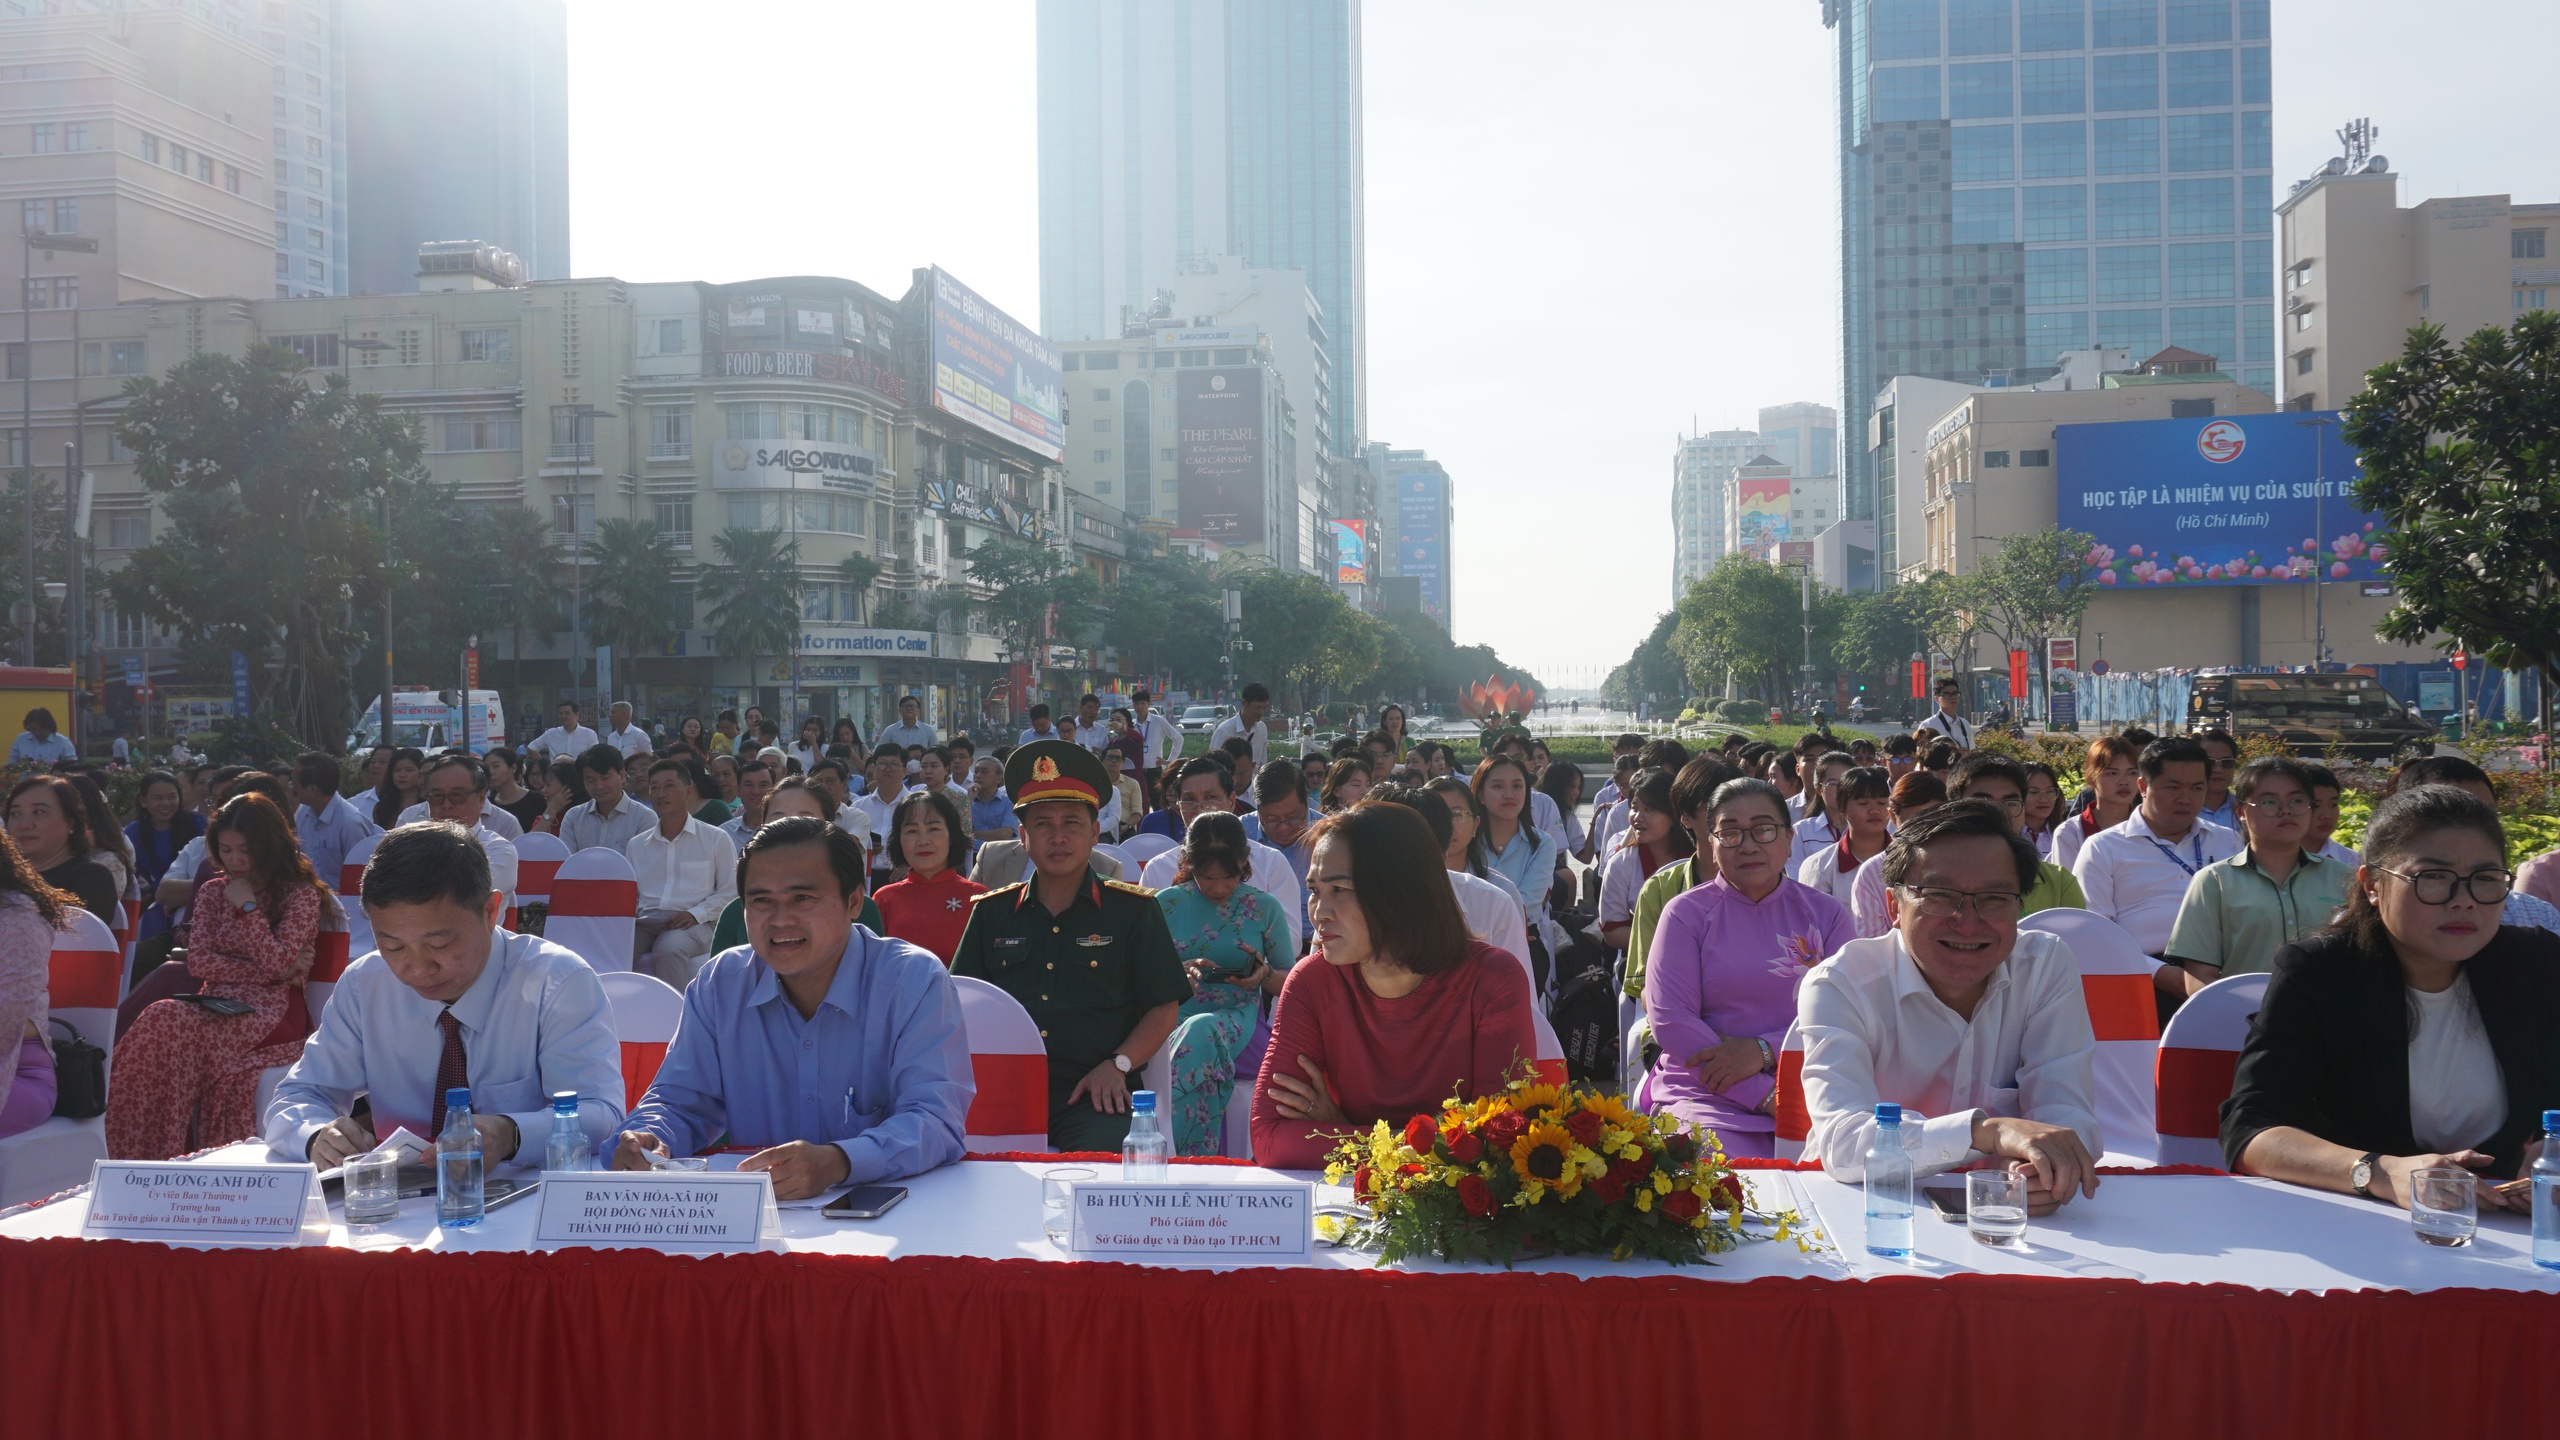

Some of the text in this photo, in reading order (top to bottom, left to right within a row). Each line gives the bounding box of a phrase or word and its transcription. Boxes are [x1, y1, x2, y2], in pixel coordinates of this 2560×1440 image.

[962, 295, 1062, 374] BỆNH VIỆN ĐA KHOA TÂM ANH
[726, 352, 906, 401] FOOD & BEER SKY ZONE
[1181, 428, 1257, 441] THE PEARL
[757, 449, 874, 476] SAIGONTOURIST
[1207, 454, 1226, 464] CẤP
[1227, 453, 1253, 464] NHẤT
[956, 484, 975, 504] CHILL
[2083, 491, 2115, 510] HỌC
[2119, 486, 2148, 508] TẬP
[2152, 484, 2170, 505] LÀ
[2175, 483, 2224, 506] NHIỆM
[2229, 485, 2250, 504] VỤ
[2255, 480, 2288, 500] CỦA
[2293, 476, 2334, 499] SUỐT
[950, 502, 981, 520] CHẤT RIÊNG
[2175, 511, 2270, 531] (Hồ Chí Minh)
[790, 634, 927, 652] nformation Center
[125, 1170, 279, 1188] Ông DƯƠNG ANH ĐỨC
[148, 1188, 161, 1200] Ủy
[163, 1190, 180, 1200] viên
[202, 1190, 236, 1202] Thường
[238, 1193, 248, 1202] vụ
[585, 1188, 718, 1205] BAN VĂN HÓA-XÃ HỘI
[1086, 1191, 1293, 1208] Bà HUỲNH LÊ NHƯ TRANG
[170, 1202, 220, 1212] Trưởng ban
[583, 1205, 715, 1220] HỘI ĐỒNG NHÂN DÂN
[92, 1213, 294, 1227] Ban Tuyên giáo và Dân vận Thành ủy TP.HCM
[568, 1221, 726, 1235] THÀNH PHỐ HỒ CHÍ MINH
[1150, 1214, 1228, 1228] Phó Giám đốc
[1095, 1234, 1280, 1248] Sở Giáo dục và Đào tạo TP.HCM
